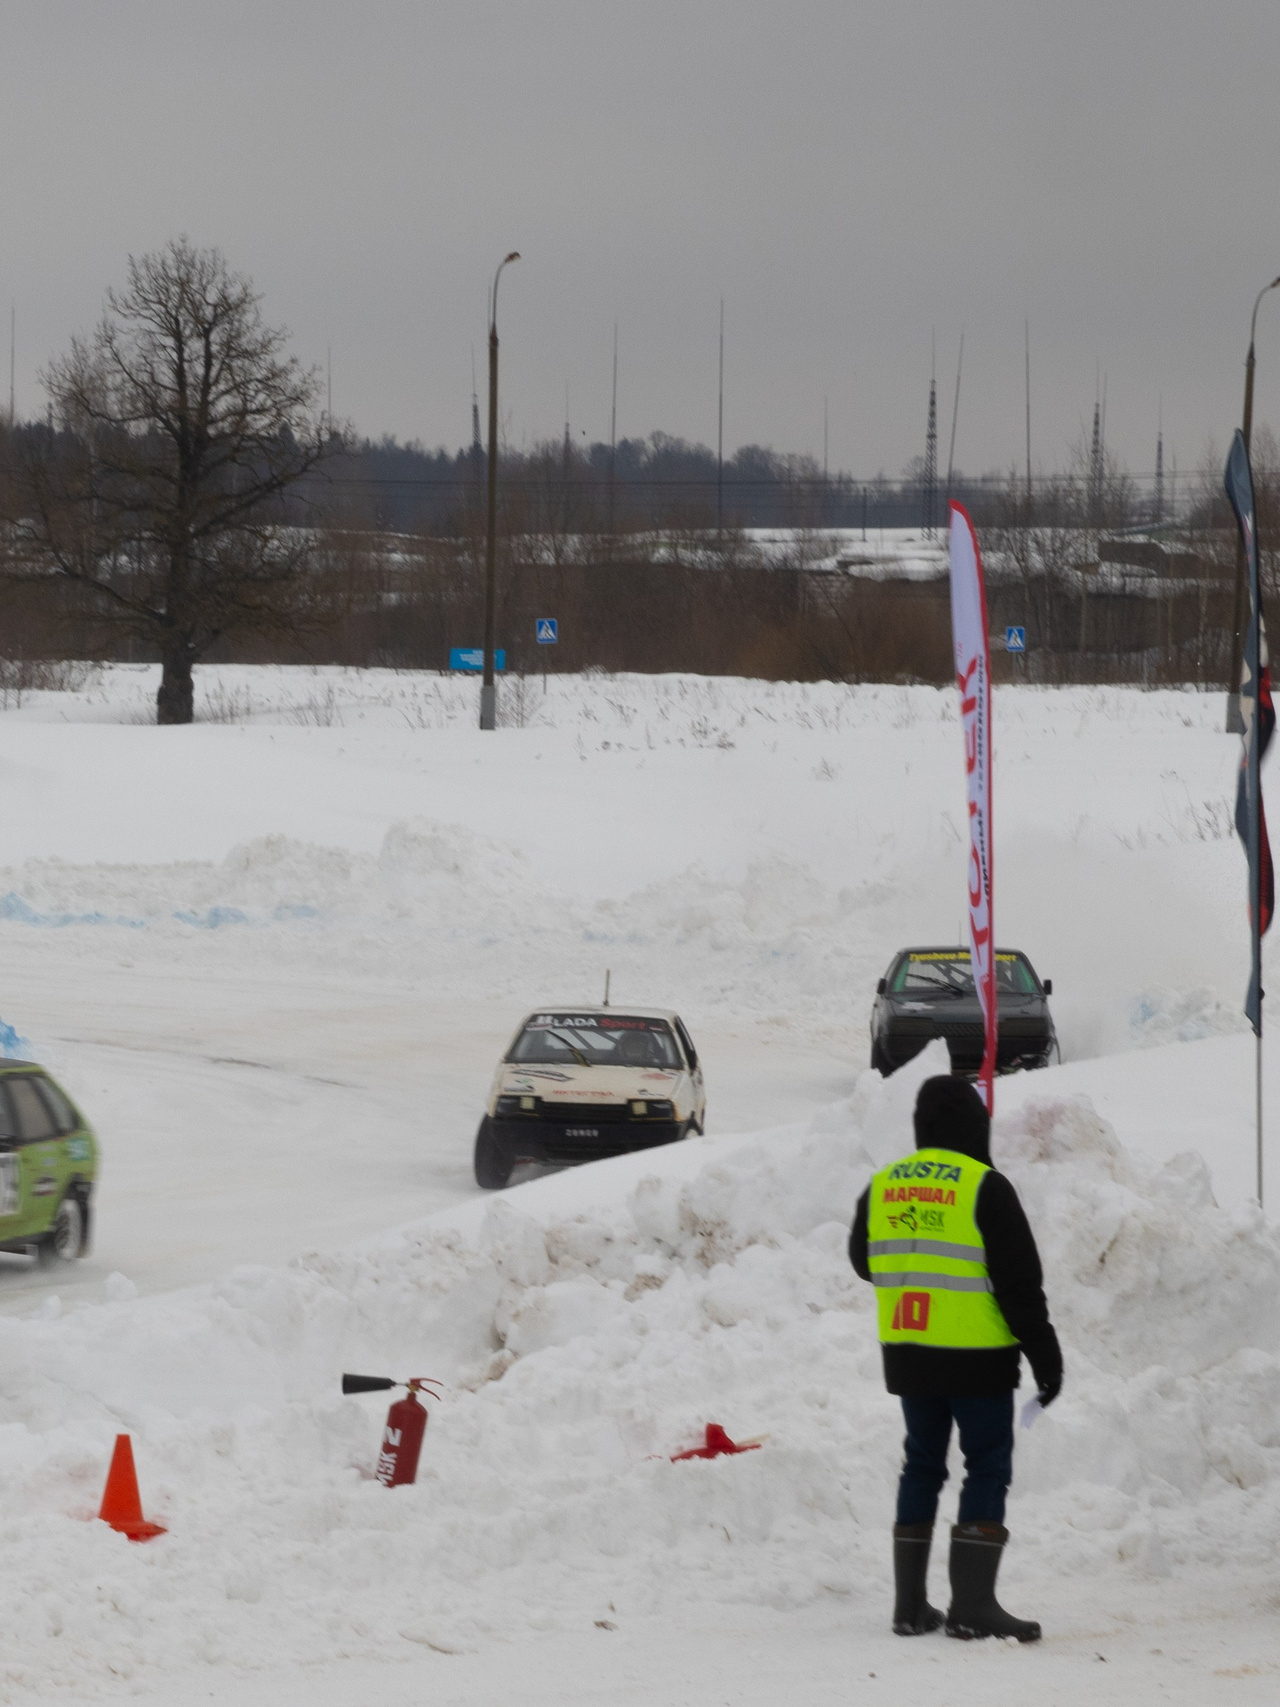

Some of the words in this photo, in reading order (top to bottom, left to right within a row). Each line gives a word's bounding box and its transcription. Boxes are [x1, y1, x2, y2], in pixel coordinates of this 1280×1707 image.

[553, 1017, 598, 1028] LADA
[888, 1161, 963, 1183] RUSTA
[883, 1187, 956, 1206] МАРШАЛ
